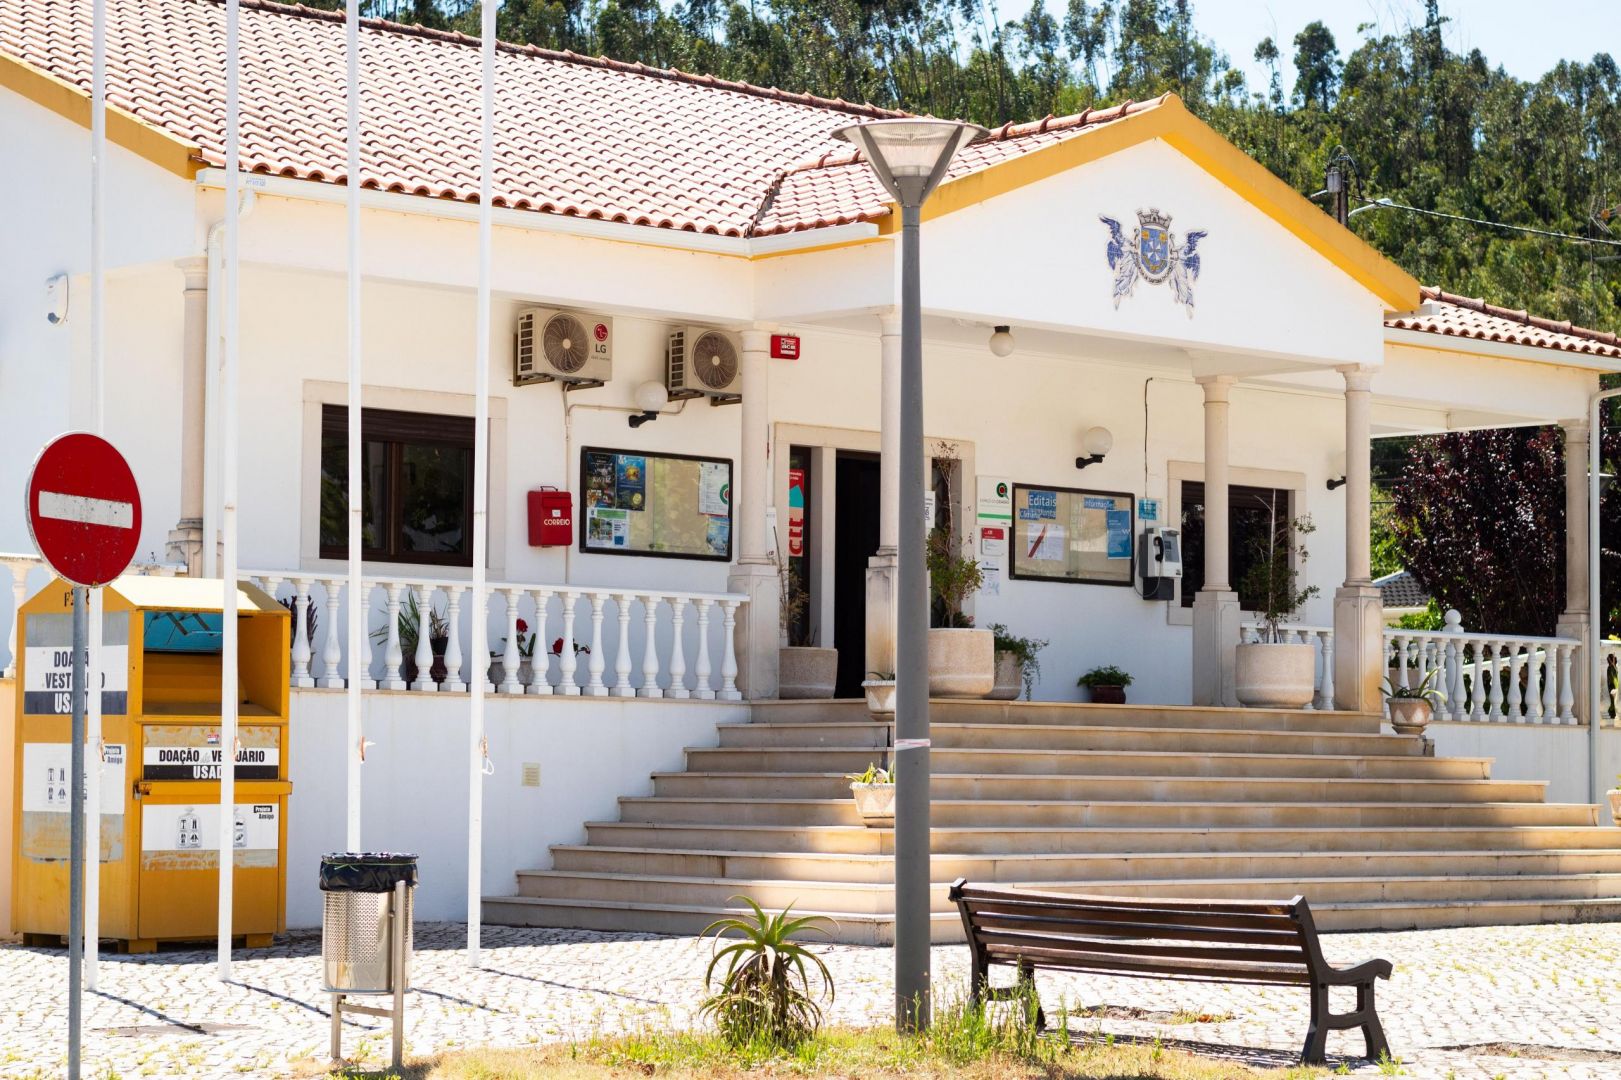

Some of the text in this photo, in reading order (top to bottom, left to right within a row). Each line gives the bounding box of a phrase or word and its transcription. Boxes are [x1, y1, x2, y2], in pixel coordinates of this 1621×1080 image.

[595, 344, 607, 353] LG
[1029, 494, 1056, 507] Editais
[543, 518, 571, 526] CORREIO
[159, 748, 200, 764] DOAÇÃO
